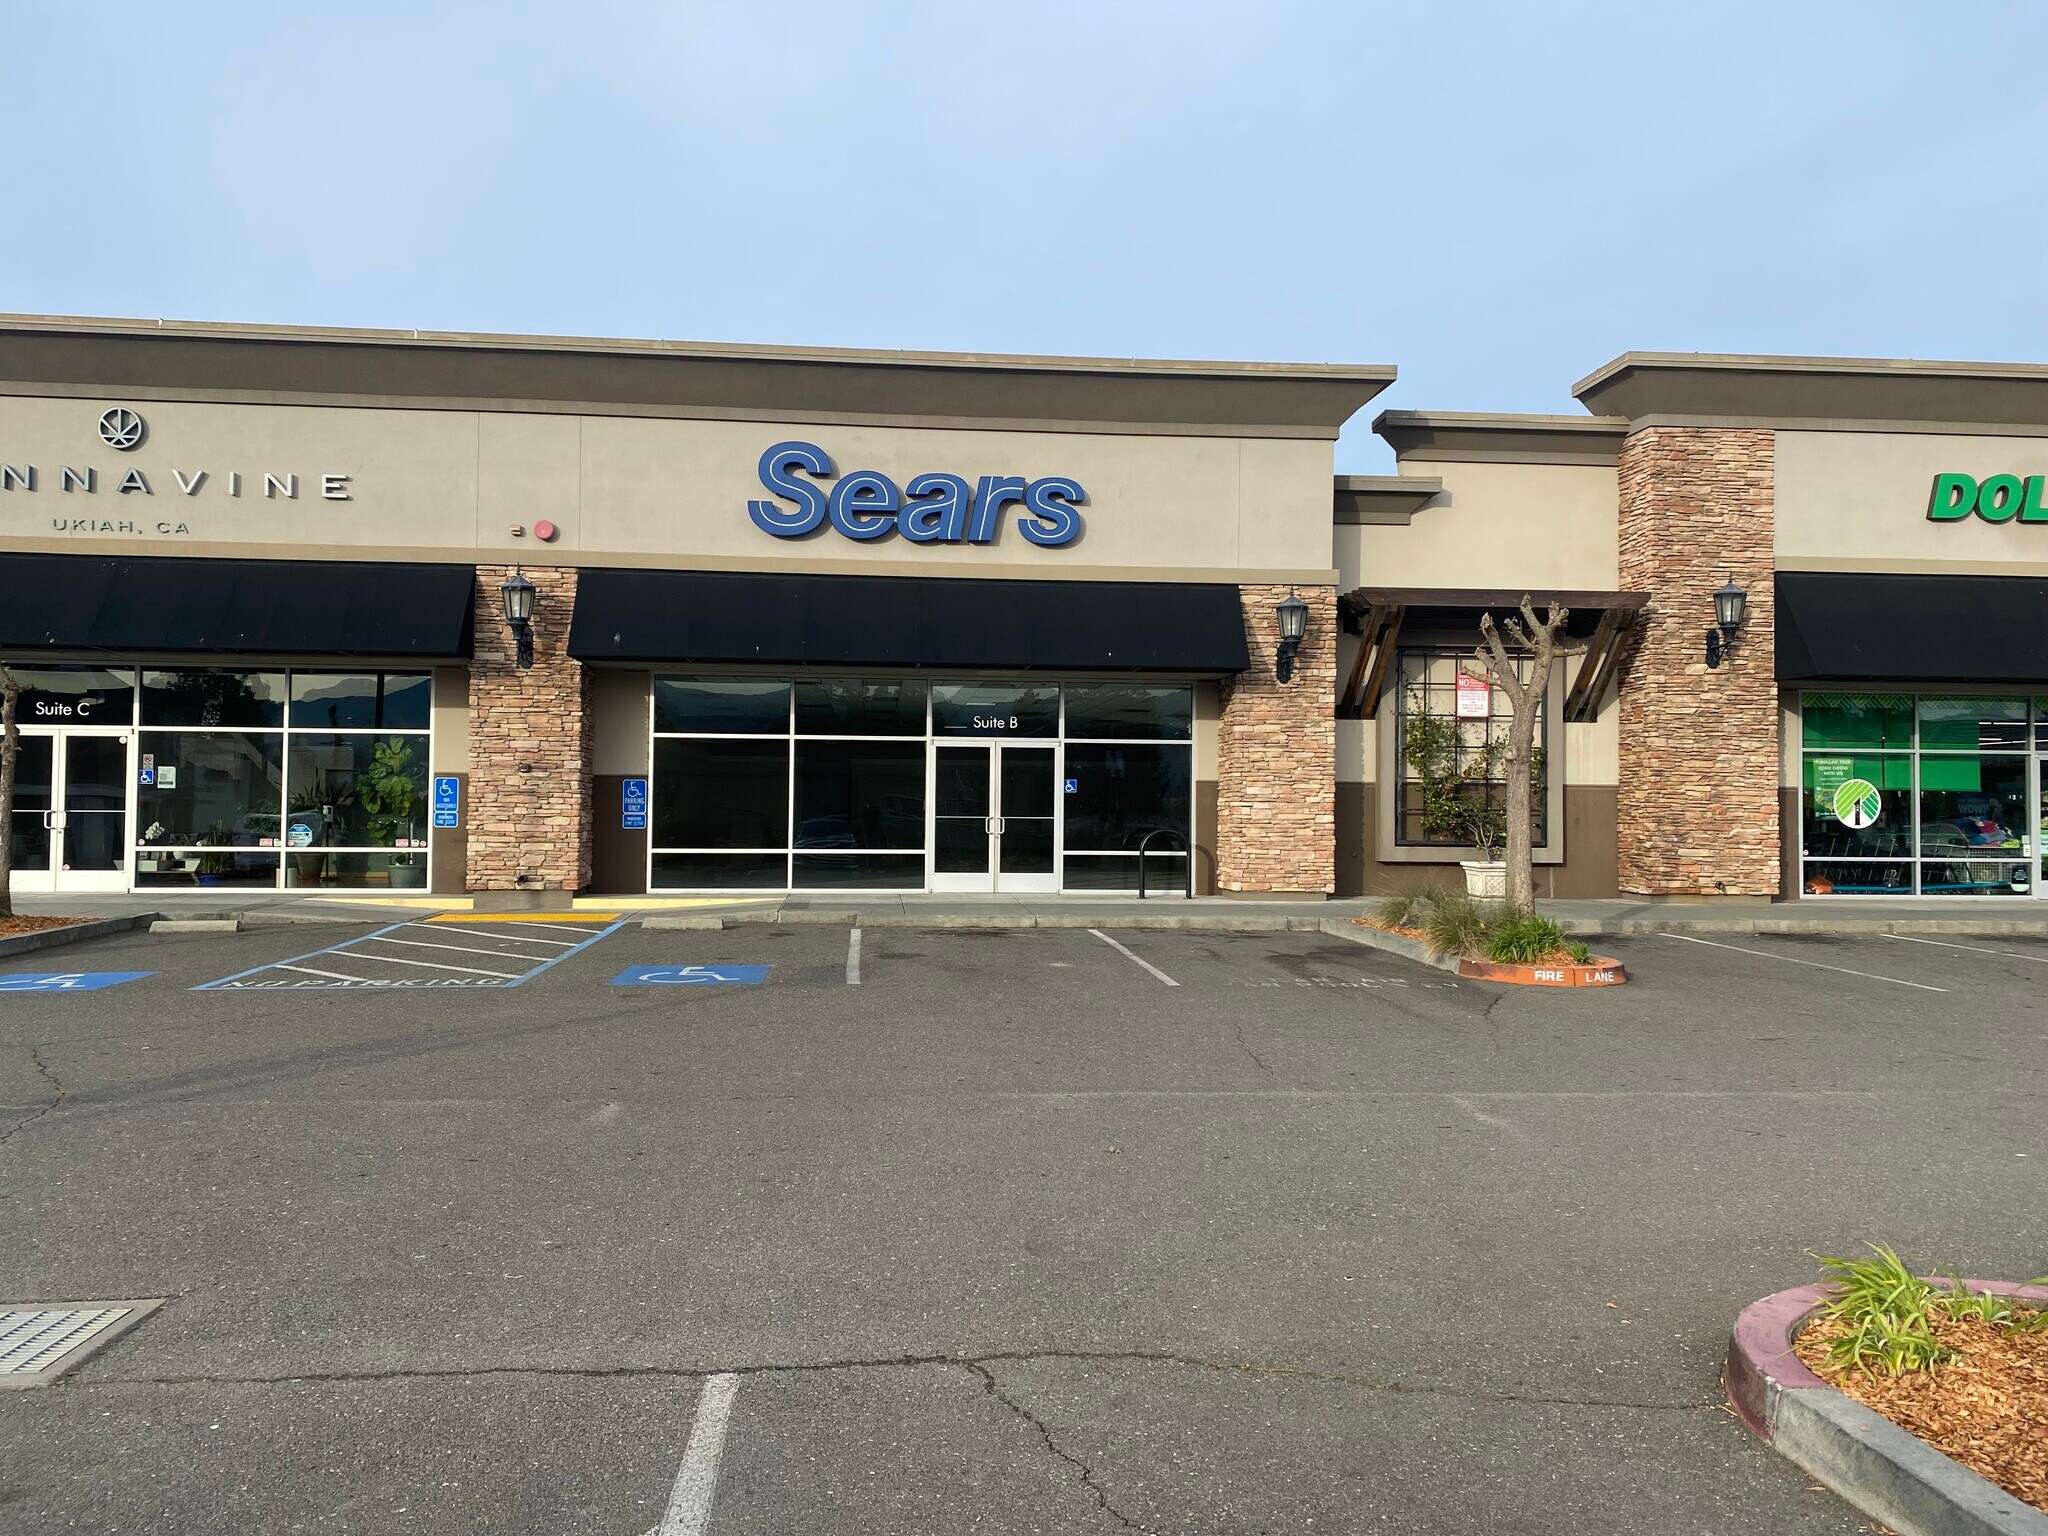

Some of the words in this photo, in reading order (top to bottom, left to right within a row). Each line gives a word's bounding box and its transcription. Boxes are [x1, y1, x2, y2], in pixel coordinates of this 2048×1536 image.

[747, 440, 1085, 545] Sears
[52, 518, 143, 535] UKIAH,
[156, 521, 190, 535] CA
[1459, 679, 1470, 687] NO
[35, 702, 72, 716] Suite
[77, 702, 90, 716] C
[973, 716, 1005, 729] Suite
[1009, 717, 1018, 729] B
[291, 977, 505, 987] PARKING
[1534, 970, 1565, 982] FIRE
[1585, 971, 1615, 983] LANE
